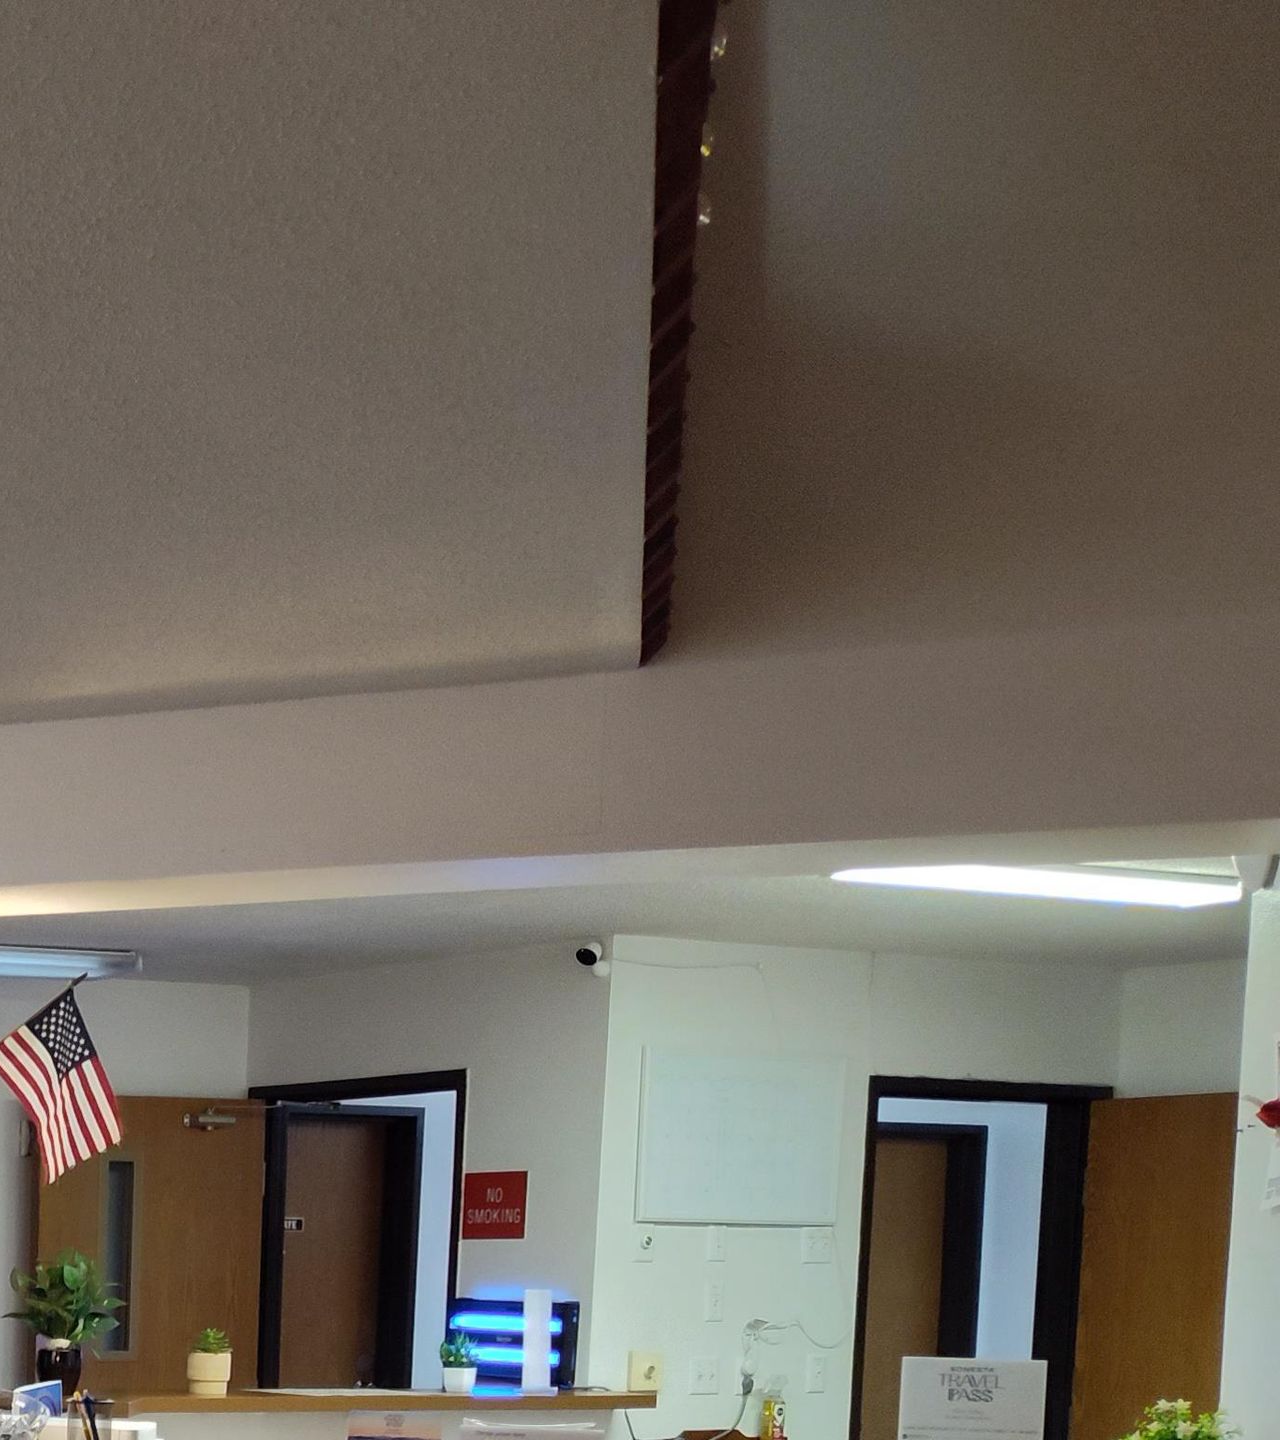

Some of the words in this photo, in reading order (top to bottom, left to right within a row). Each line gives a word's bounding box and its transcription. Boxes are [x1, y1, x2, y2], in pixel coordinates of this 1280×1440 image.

[486, 1187, 503, 1203] NO
[467, 1208, 521, 1224] SMOKING
[939, 1373, 1007, 1389] TRAVEL
[948, 1388, 994, 1402] PASS
